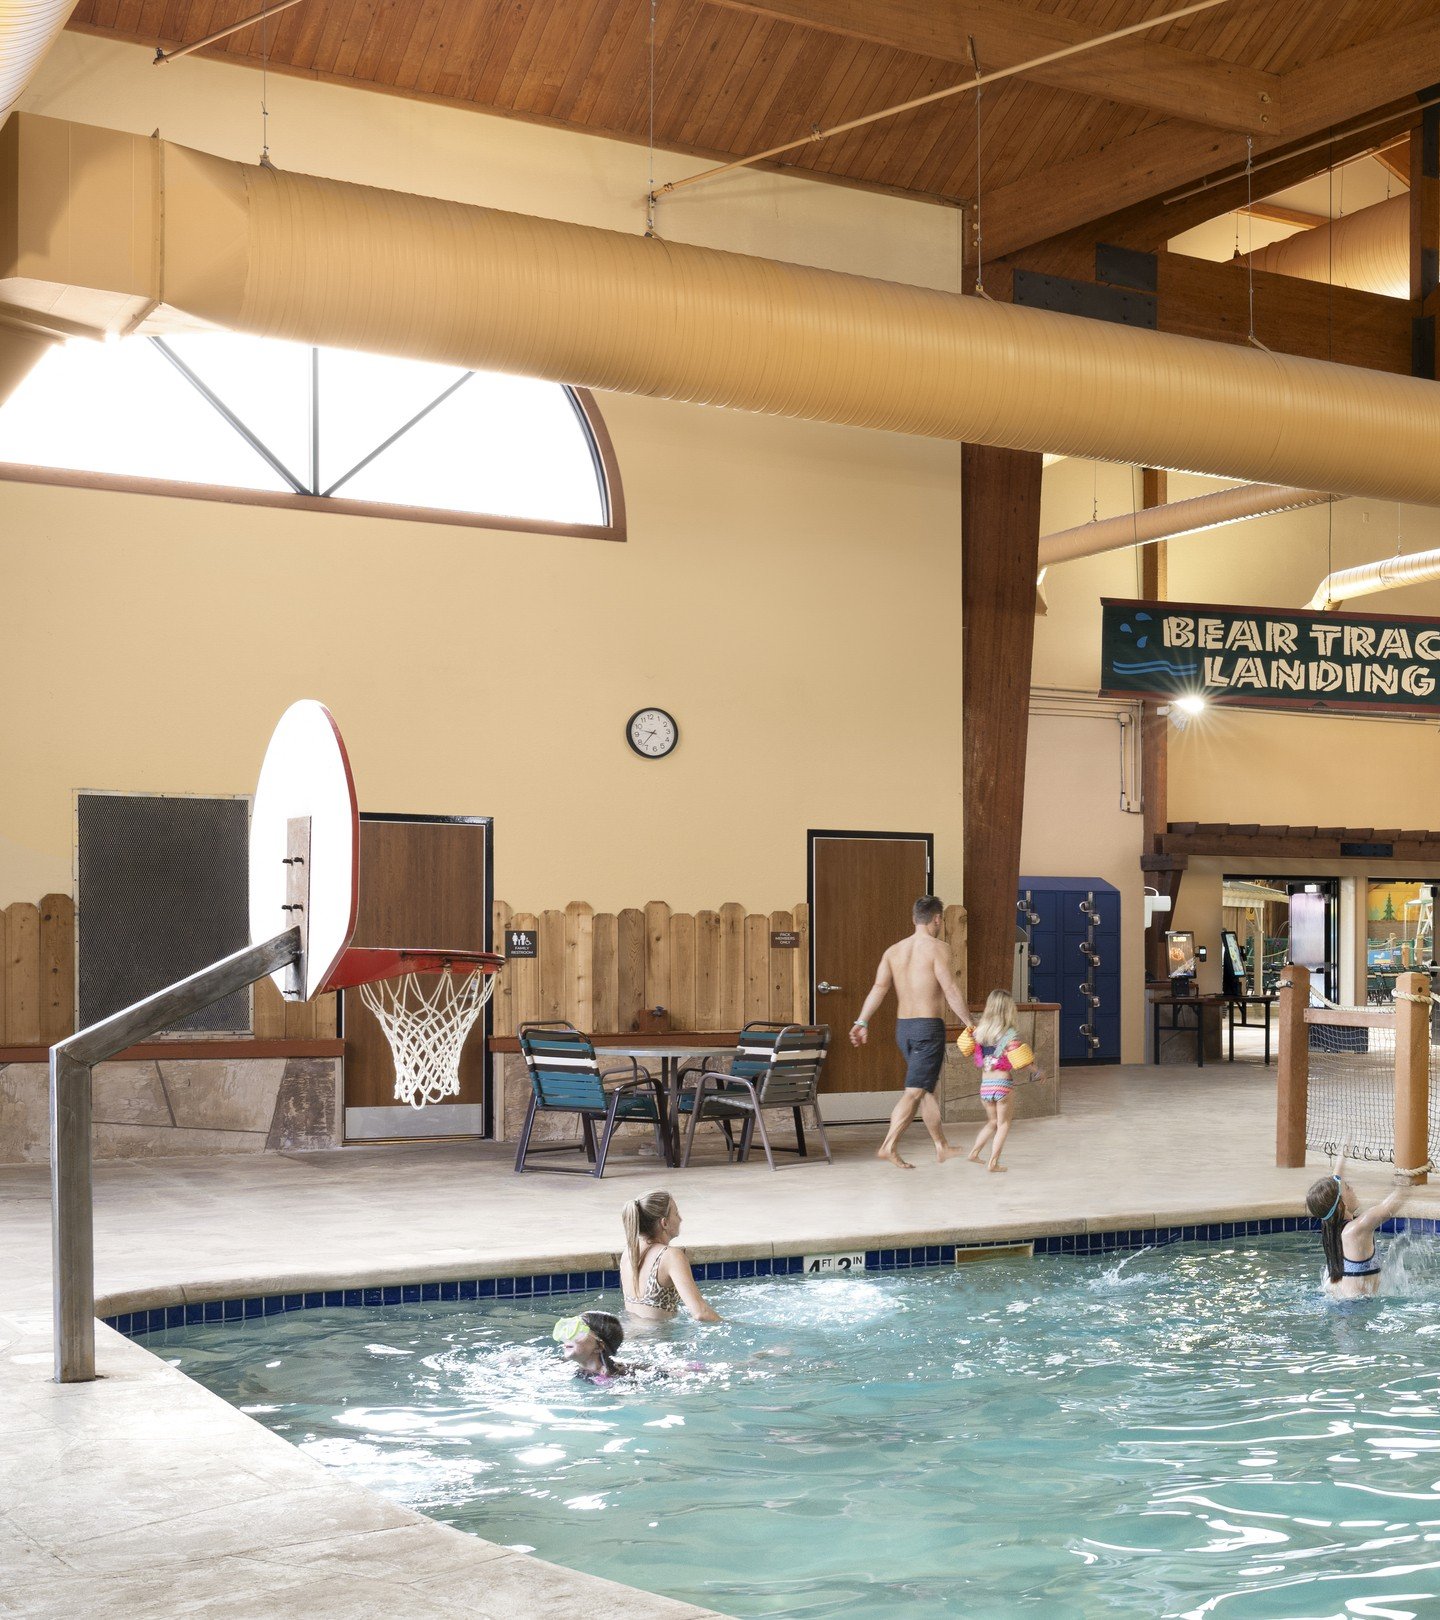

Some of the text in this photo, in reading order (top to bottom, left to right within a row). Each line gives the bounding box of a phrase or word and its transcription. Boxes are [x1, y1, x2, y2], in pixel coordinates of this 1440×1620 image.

[1162, 616, 1299, 655] BEAR
[1203, 656, 1436, 697] LANDING
[822, 1258, 832, 1267] FT
[853, 1256, 863, 1265] IN
